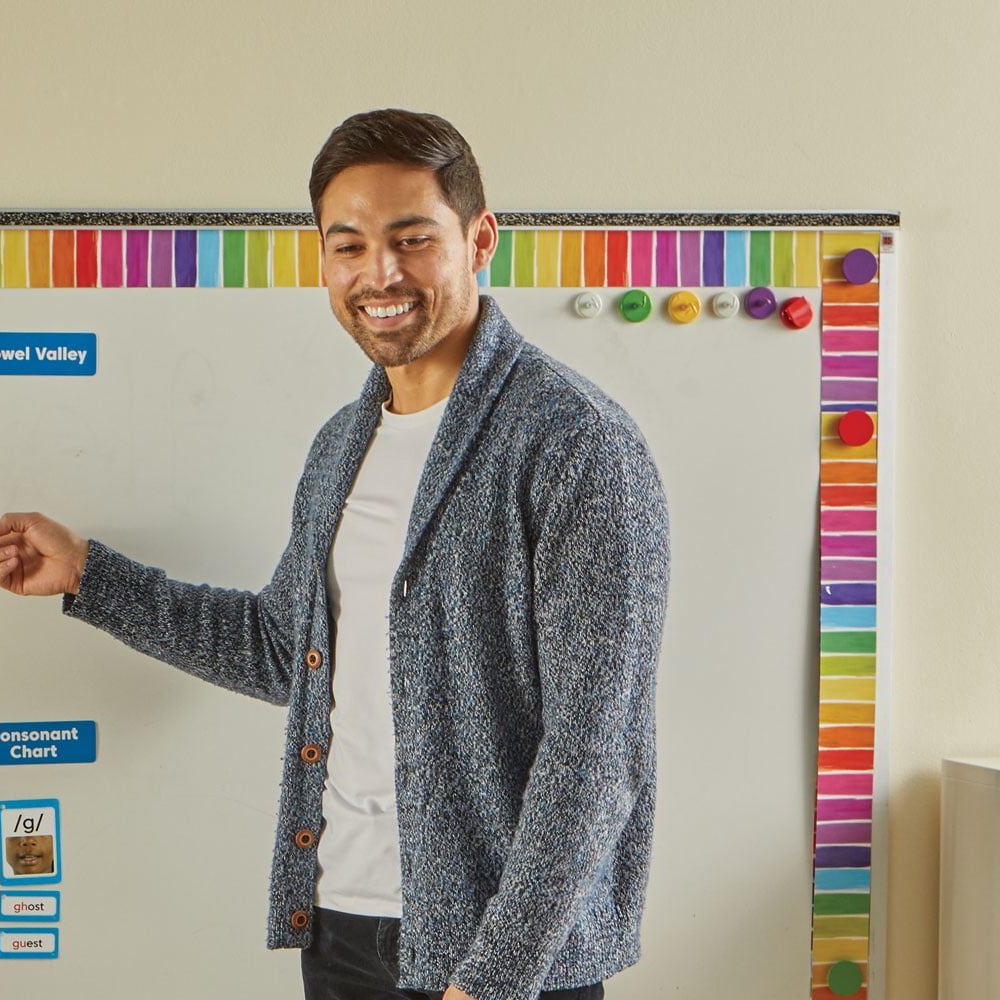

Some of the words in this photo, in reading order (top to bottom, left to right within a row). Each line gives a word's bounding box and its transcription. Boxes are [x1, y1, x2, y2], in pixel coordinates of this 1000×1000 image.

[35, 346, 88, 365] Valley
[10, 745, 57, 759] Chart
[14, 814, 43, 833] /g/
[13, 901, 45, 914] ghost
[11, 939, 44, 952] guest
